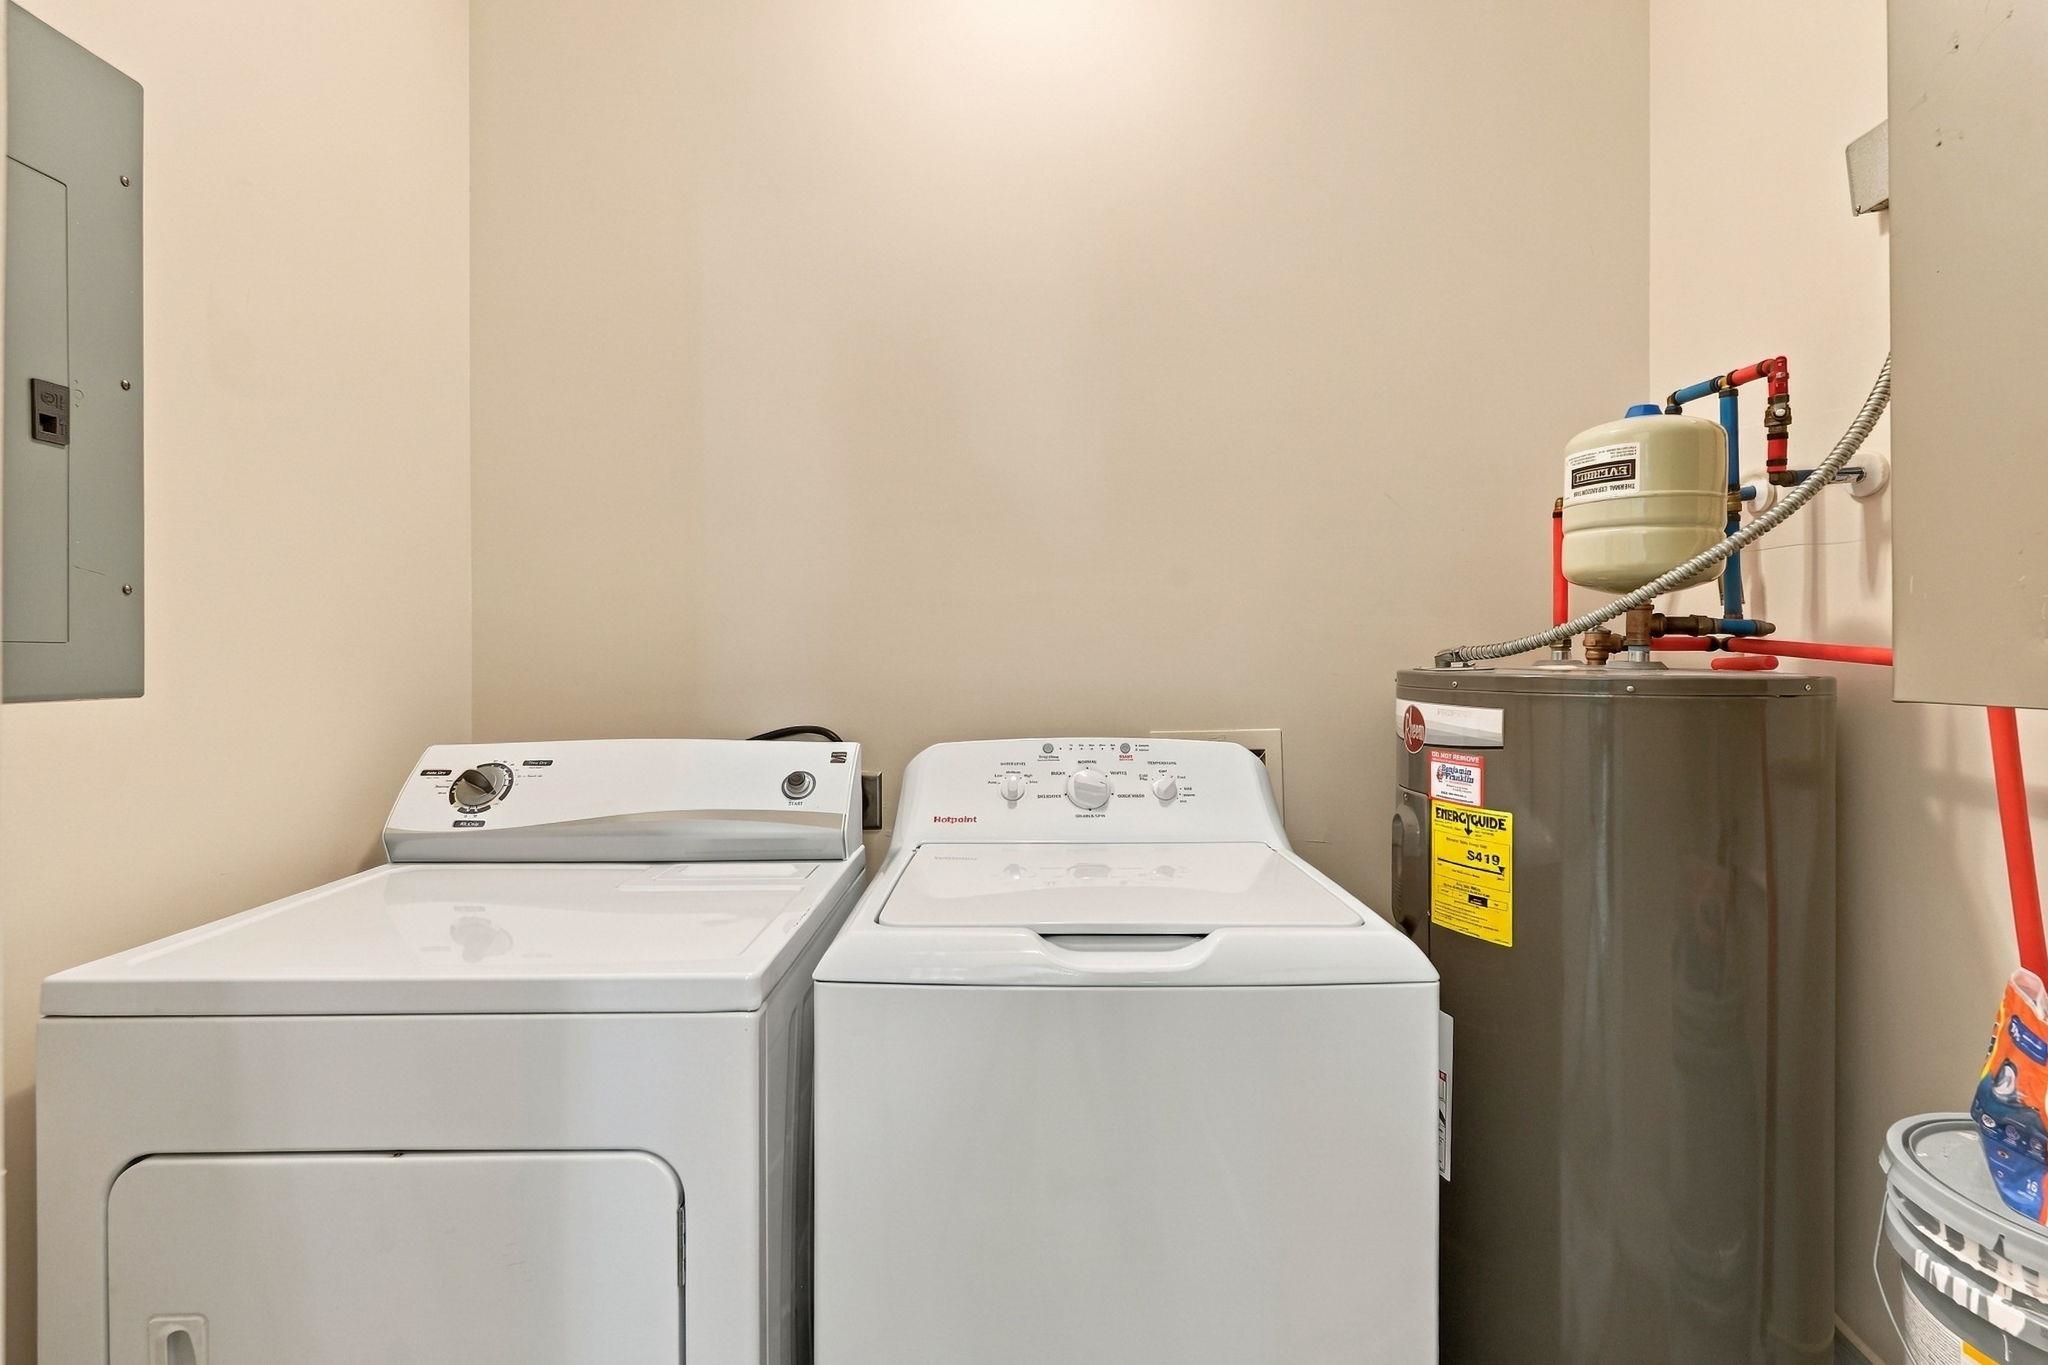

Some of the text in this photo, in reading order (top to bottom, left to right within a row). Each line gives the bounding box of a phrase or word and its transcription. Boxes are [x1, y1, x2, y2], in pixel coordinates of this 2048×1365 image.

[1609, 483, 1635, 491] THERMAL
[1404, 706, 1424, 745] Rheem
[1452, 754, 1480, 763] REMOVE
[1441, 764, 1472, 776] Benjamin
[1445, 772, 1474, 784] Franklin
[933, 815, 978, 824] Hotpoint
